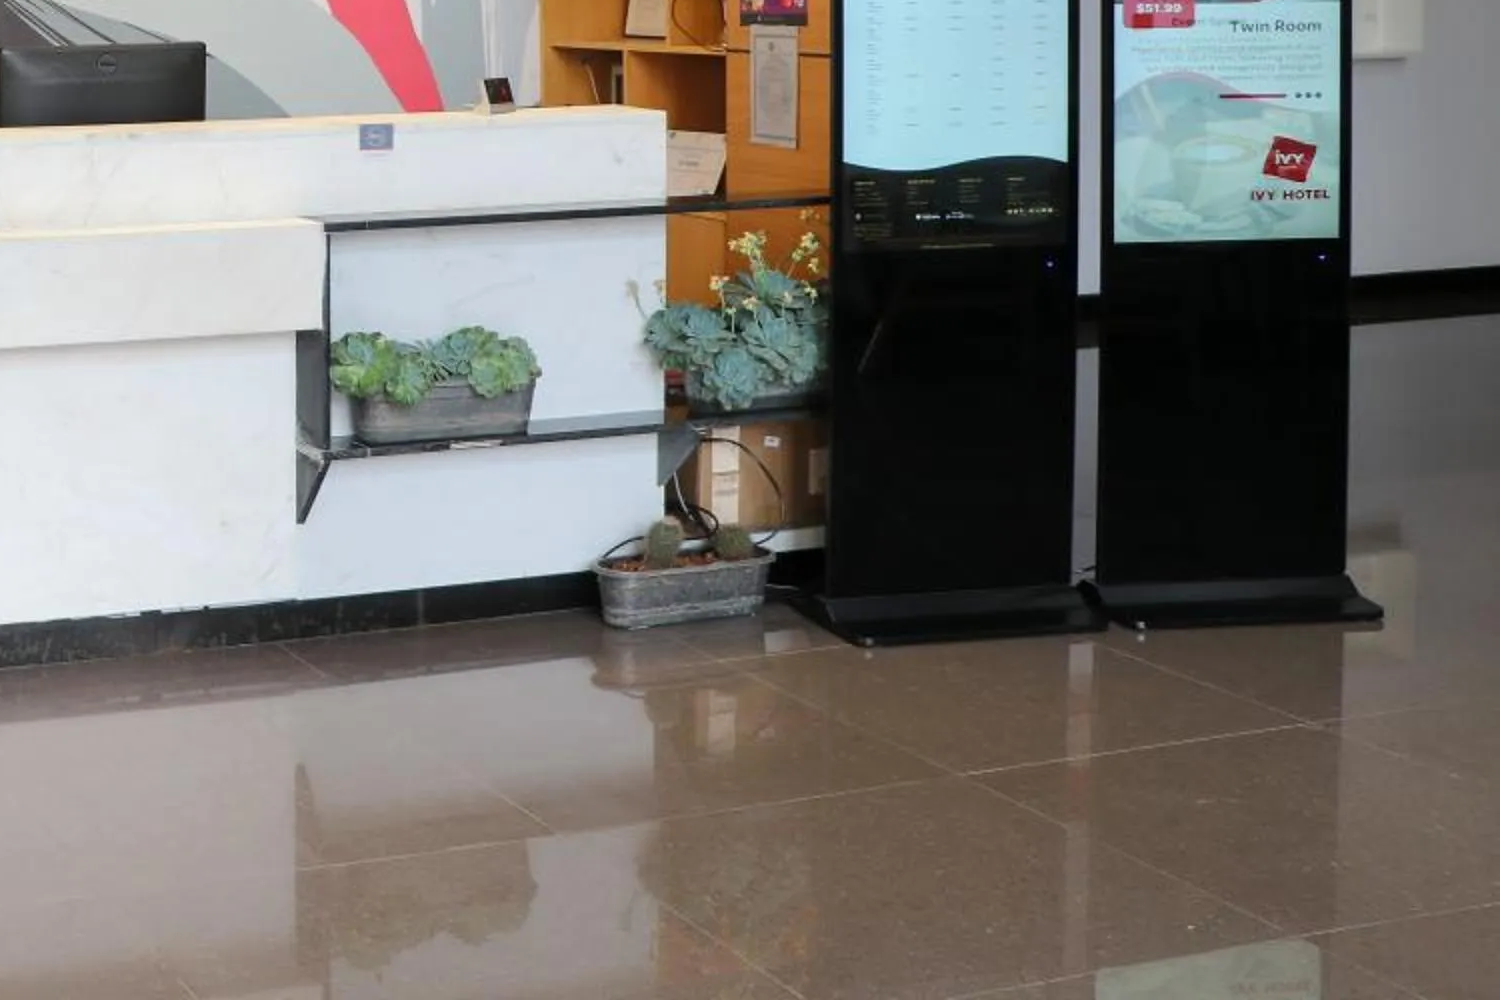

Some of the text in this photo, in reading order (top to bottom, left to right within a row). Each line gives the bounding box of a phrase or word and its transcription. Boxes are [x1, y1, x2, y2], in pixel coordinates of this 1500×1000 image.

[1230, 20, 1270, 33] Twin
[1274, 20, 1323, 33] Room
[1251, 188, 1331, 201] IVY HOTEL
